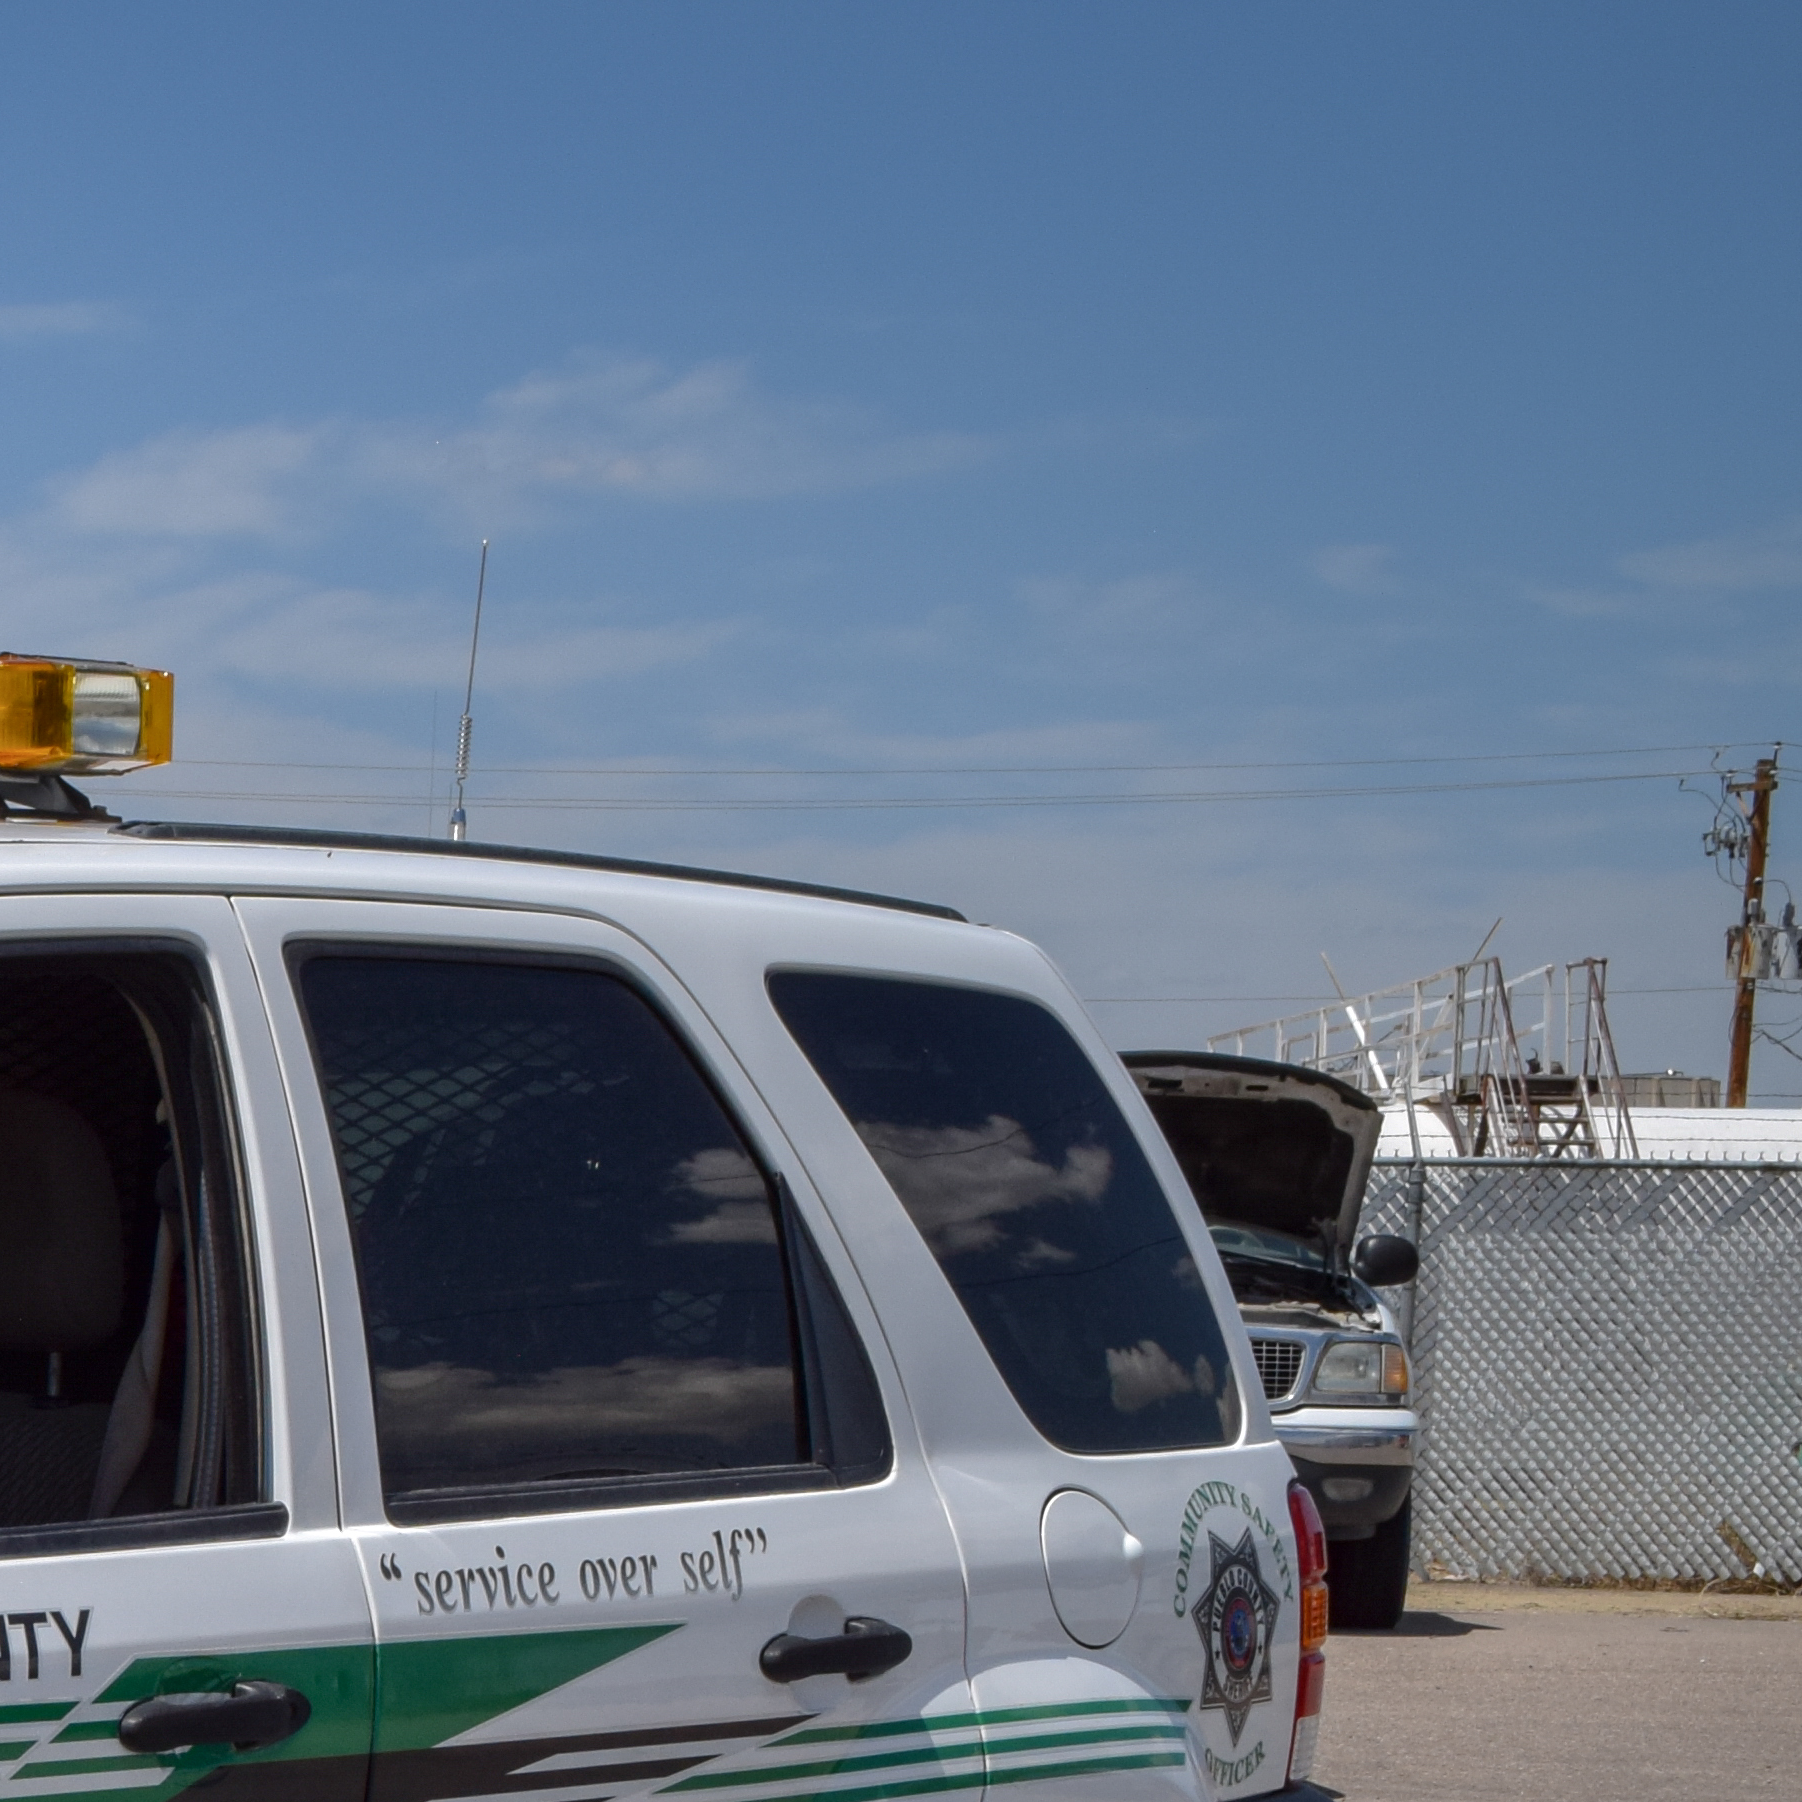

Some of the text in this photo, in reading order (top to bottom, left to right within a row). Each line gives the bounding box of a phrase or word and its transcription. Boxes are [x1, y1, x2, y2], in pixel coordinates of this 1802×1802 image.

[1173, 1481, 1294, 1618] COMMUNITY SAFETY
[579, 1554, 658, 1600] over
[1206, 1741, 1266, 1787] OFFICER
